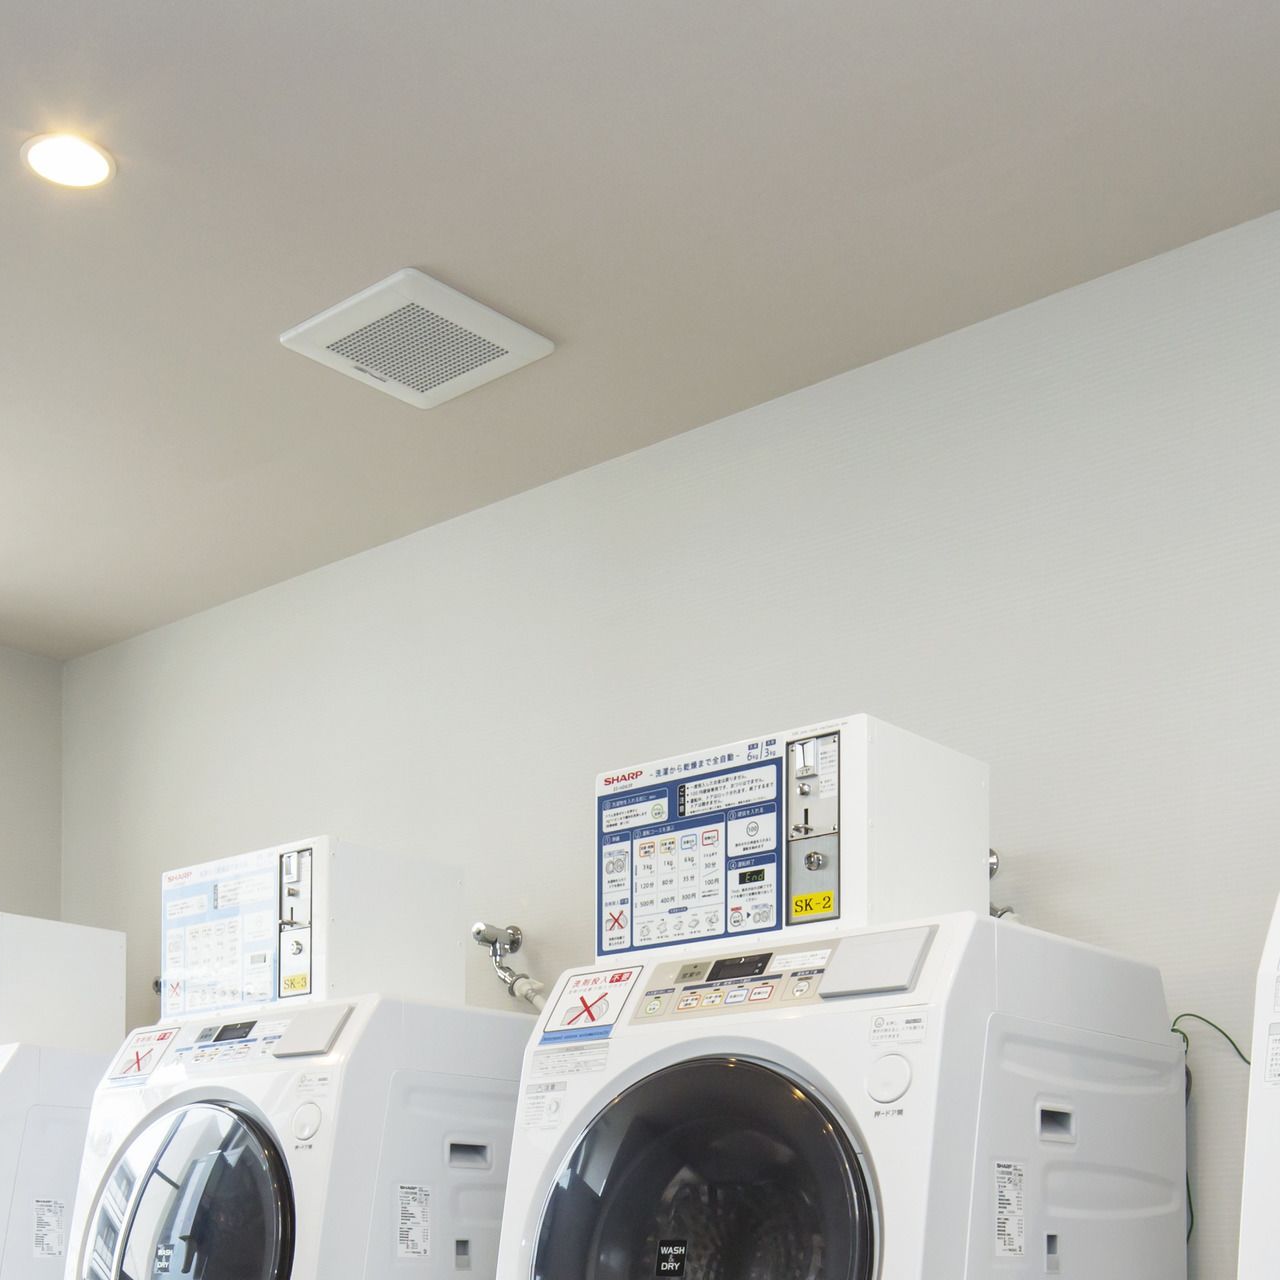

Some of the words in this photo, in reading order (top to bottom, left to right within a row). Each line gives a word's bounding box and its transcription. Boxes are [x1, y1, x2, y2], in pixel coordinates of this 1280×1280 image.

[603, 770, 644, 786] SHARP
[167, 871, 193, 883] SHARP
[794, 896, 831, 913] SK-2
[283, 976, 308, 990] SK-3
[157, 1248, 173, 1256] WASH
[660, 1246, 686, 1254] WASH
[156, 1261, 169, 1269] DRY
[660, 1262, 681, 1271] DRY
